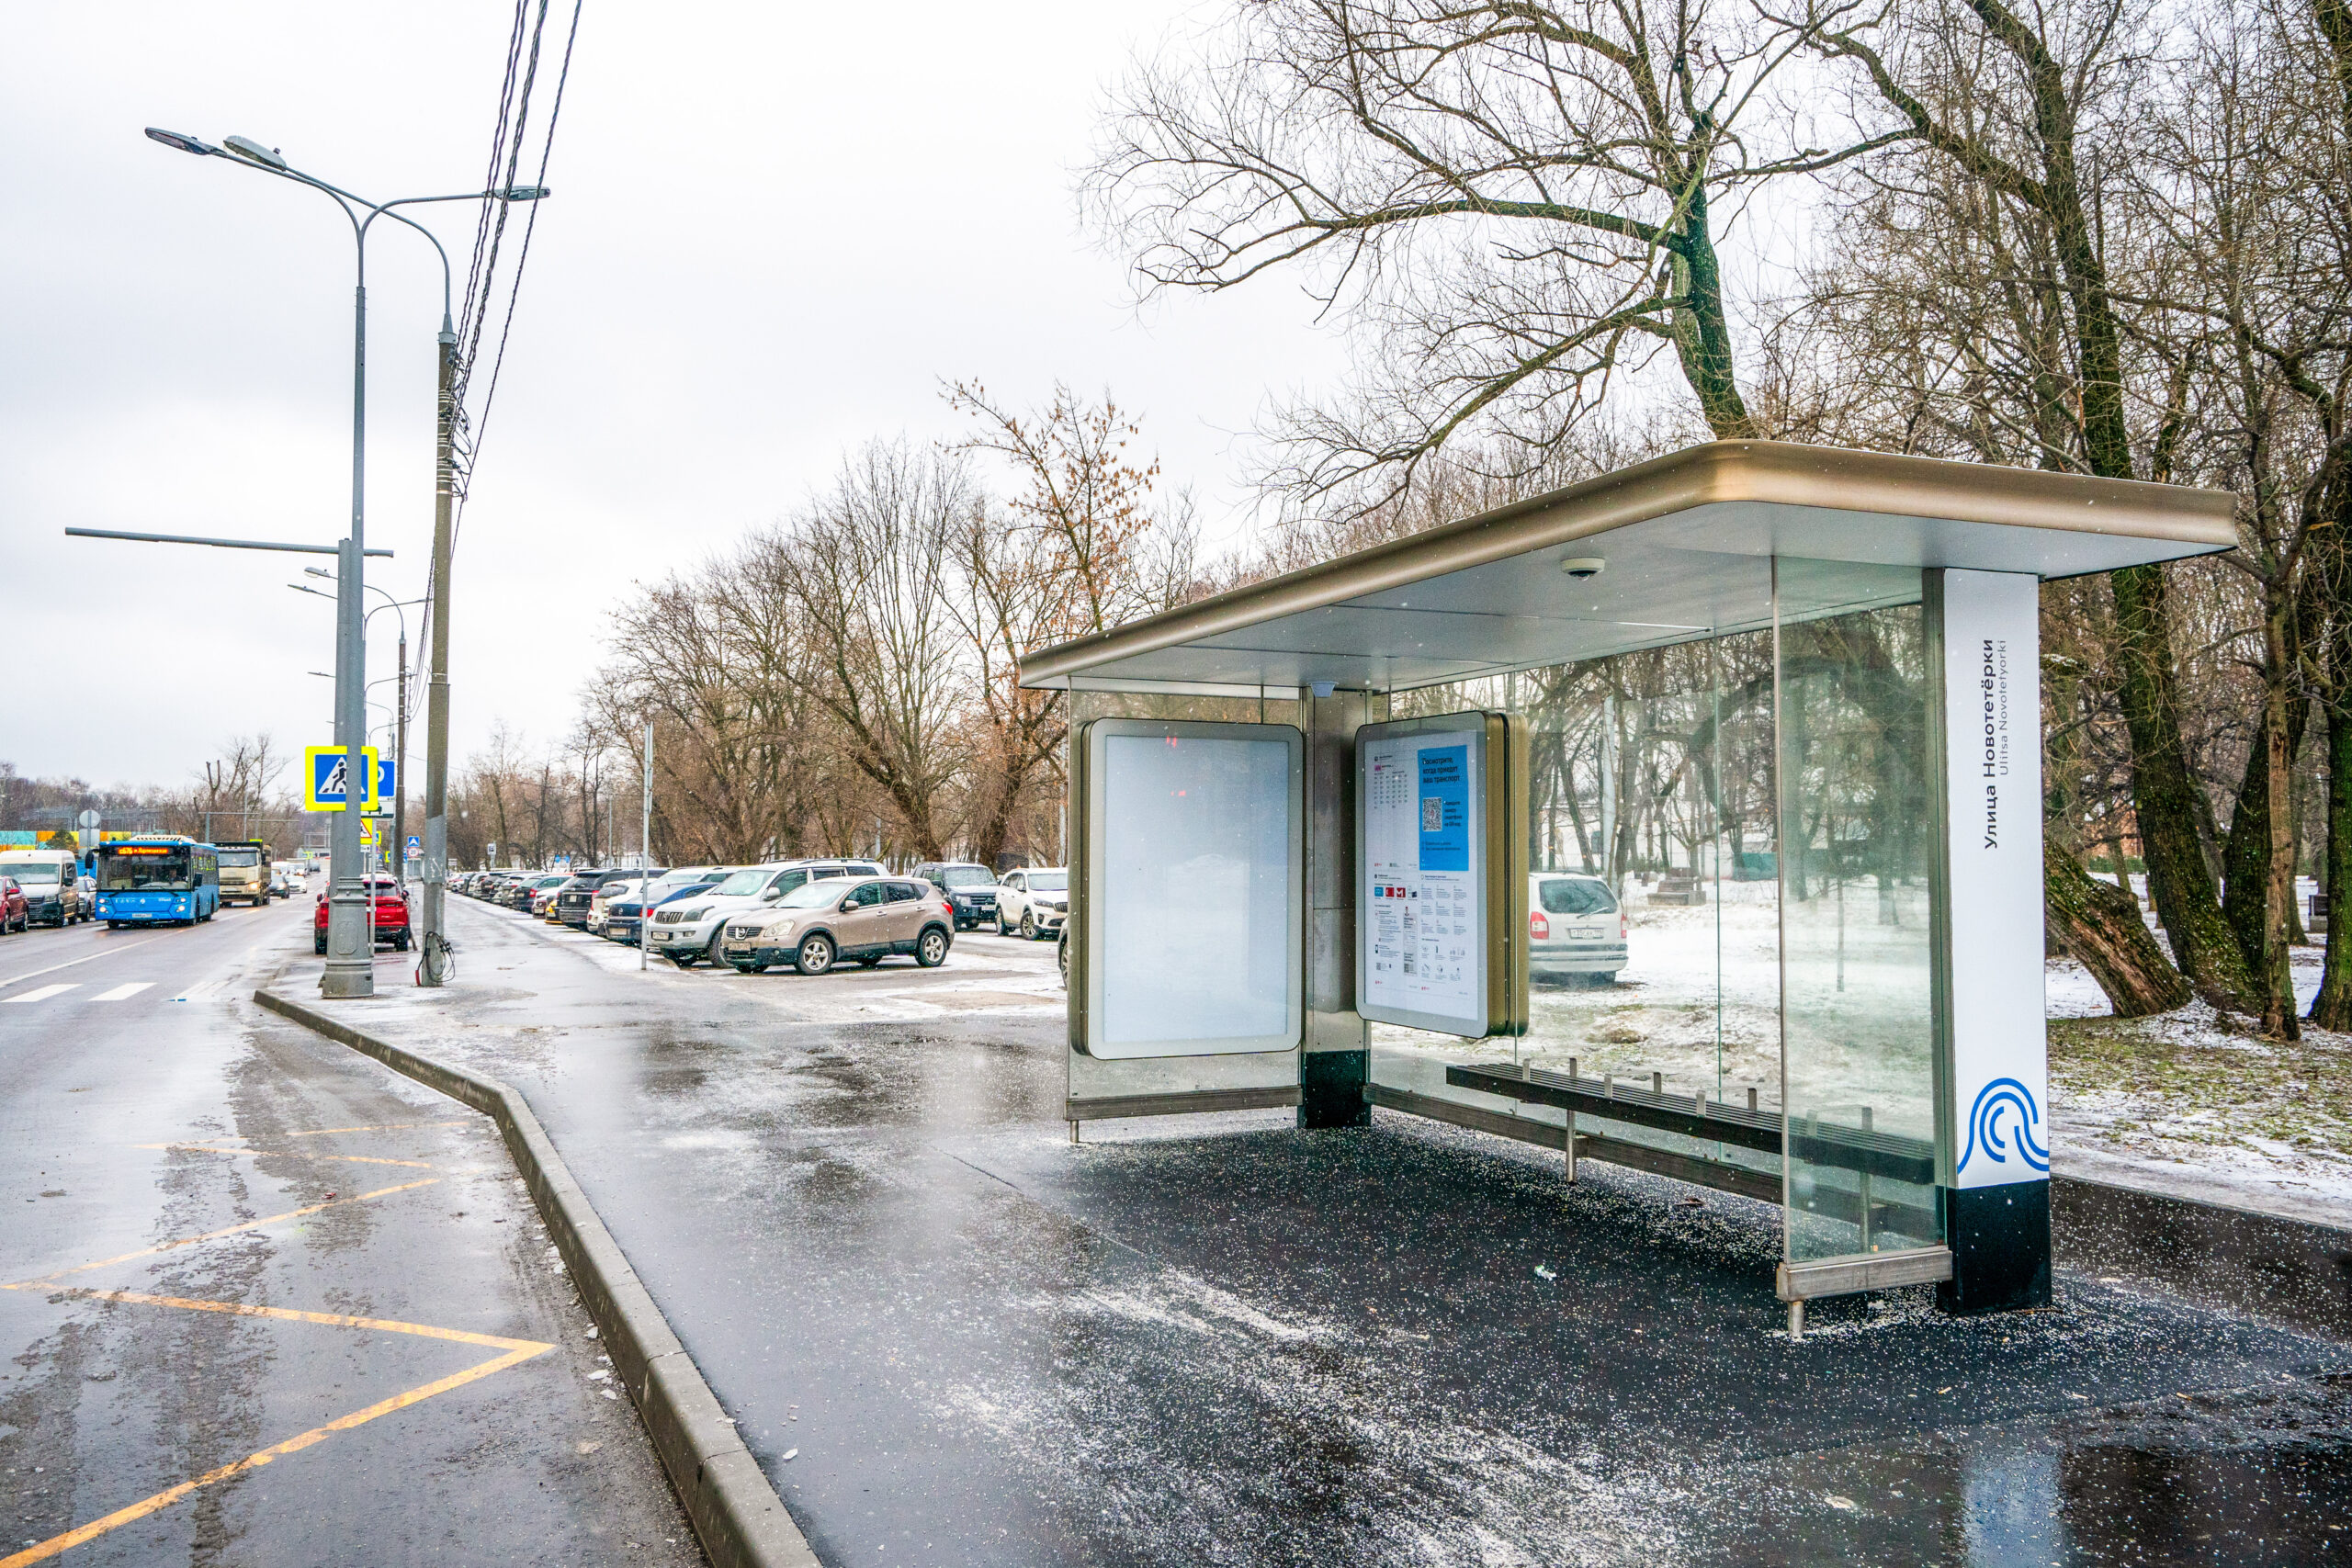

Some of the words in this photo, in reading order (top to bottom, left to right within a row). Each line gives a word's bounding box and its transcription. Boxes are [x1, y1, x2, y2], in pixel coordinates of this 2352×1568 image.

[1981, 639, 1996, 777] Новотетёрки
[1997, 640, 2008, 730] Novotetyorki
[1999, 735, 2009, 775] Ulitsa
[1984, 785, 1998, 849] Улица
